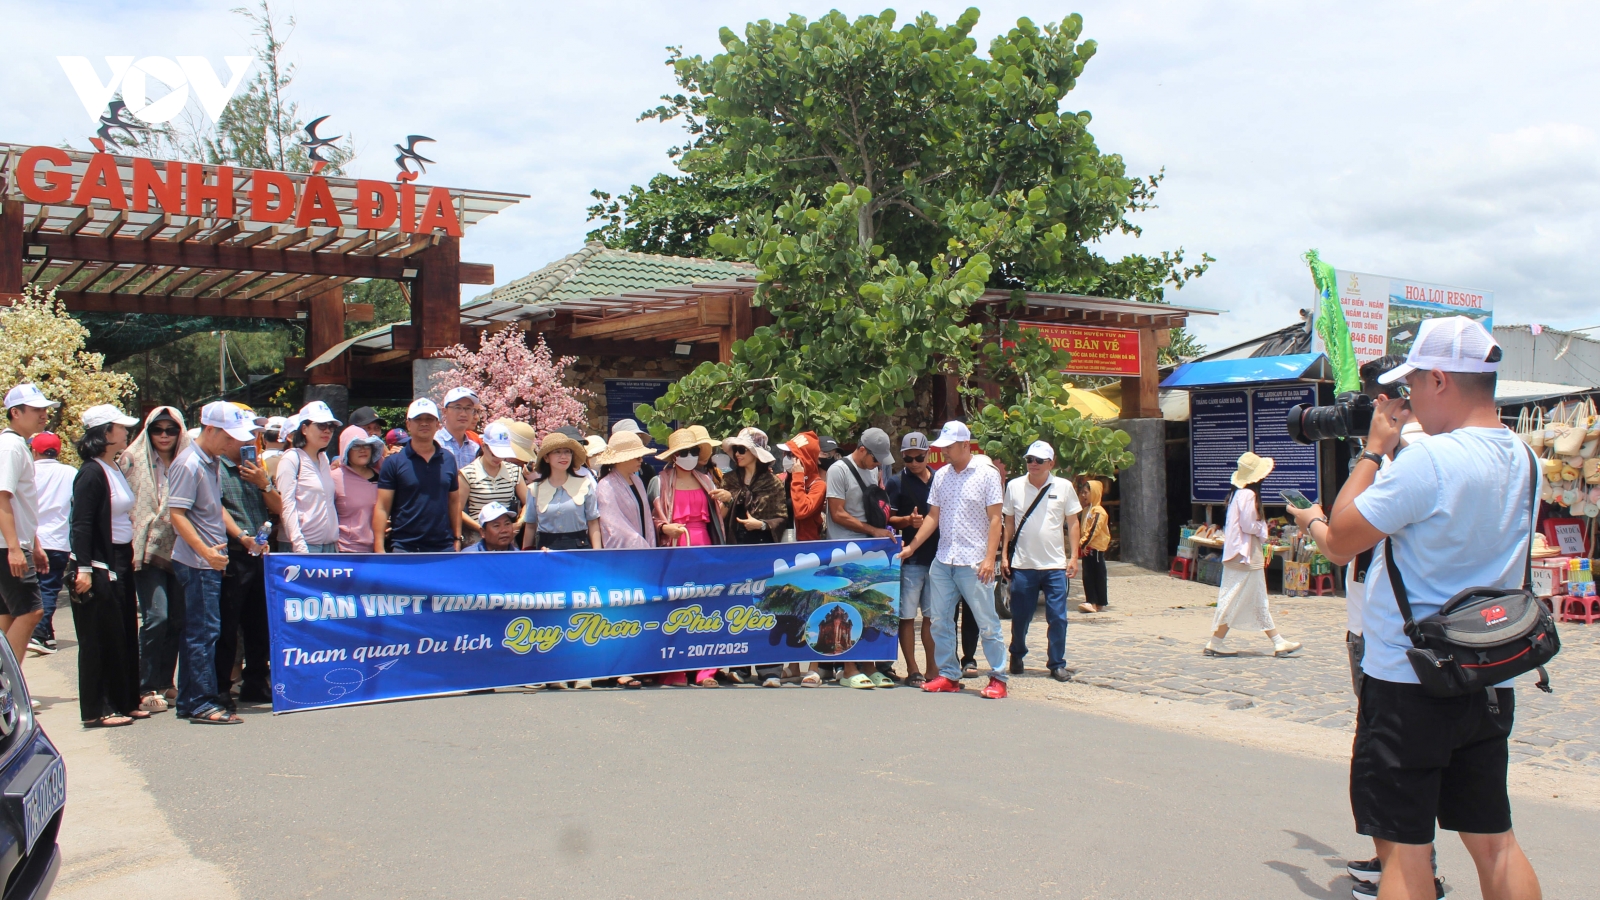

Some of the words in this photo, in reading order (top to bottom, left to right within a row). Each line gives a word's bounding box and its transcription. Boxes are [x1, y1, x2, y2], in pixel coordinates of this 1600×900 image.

[16, 137, 235, 219] GÀNH
[247, 161, 343, 229] ĐÁ
[352, 170, 462, 236] ĐĨA
[1406, 286, 1426, 301] HOA
[1429, 289, 1444, 304] LOI
[1447, 292, 1483, 308] RESORT
[1074, 337, 1099, 350] BÁN
[1103, 339, 1120, 351] VÉ
[1351, 332, 1365, 342] 846
[1368, 334, 1383, 344] 660
[1354, 347, 1382, 356] sort.com
[305, 568, 353, 578] VNPT
[284, 593, 356, 622] ĐOÀN
[361, 594, 427, 618] VNPT
[432, 592, 565, 612] VINAPHONE
[572, 586, 602, 609] BÀ
[667, 582, 725, 601] VŨNG
[728, 578, 767, 596] TÀU
[502, 616, 564, 655] Quy
[566, 612, 641, 646] Nhơn
[662, 604, 724, 636] Phú
[725, 605, 777, 635] Yên
[282, 647, 347, 667] Tham
[352, 643, 410, 663] quan
[417, 637, 447, 654] Du
[453, 634, 493, 655] lịch
[660, 647, 674, 659] 17
[688, 642, 748, 657] 20/7/2025
